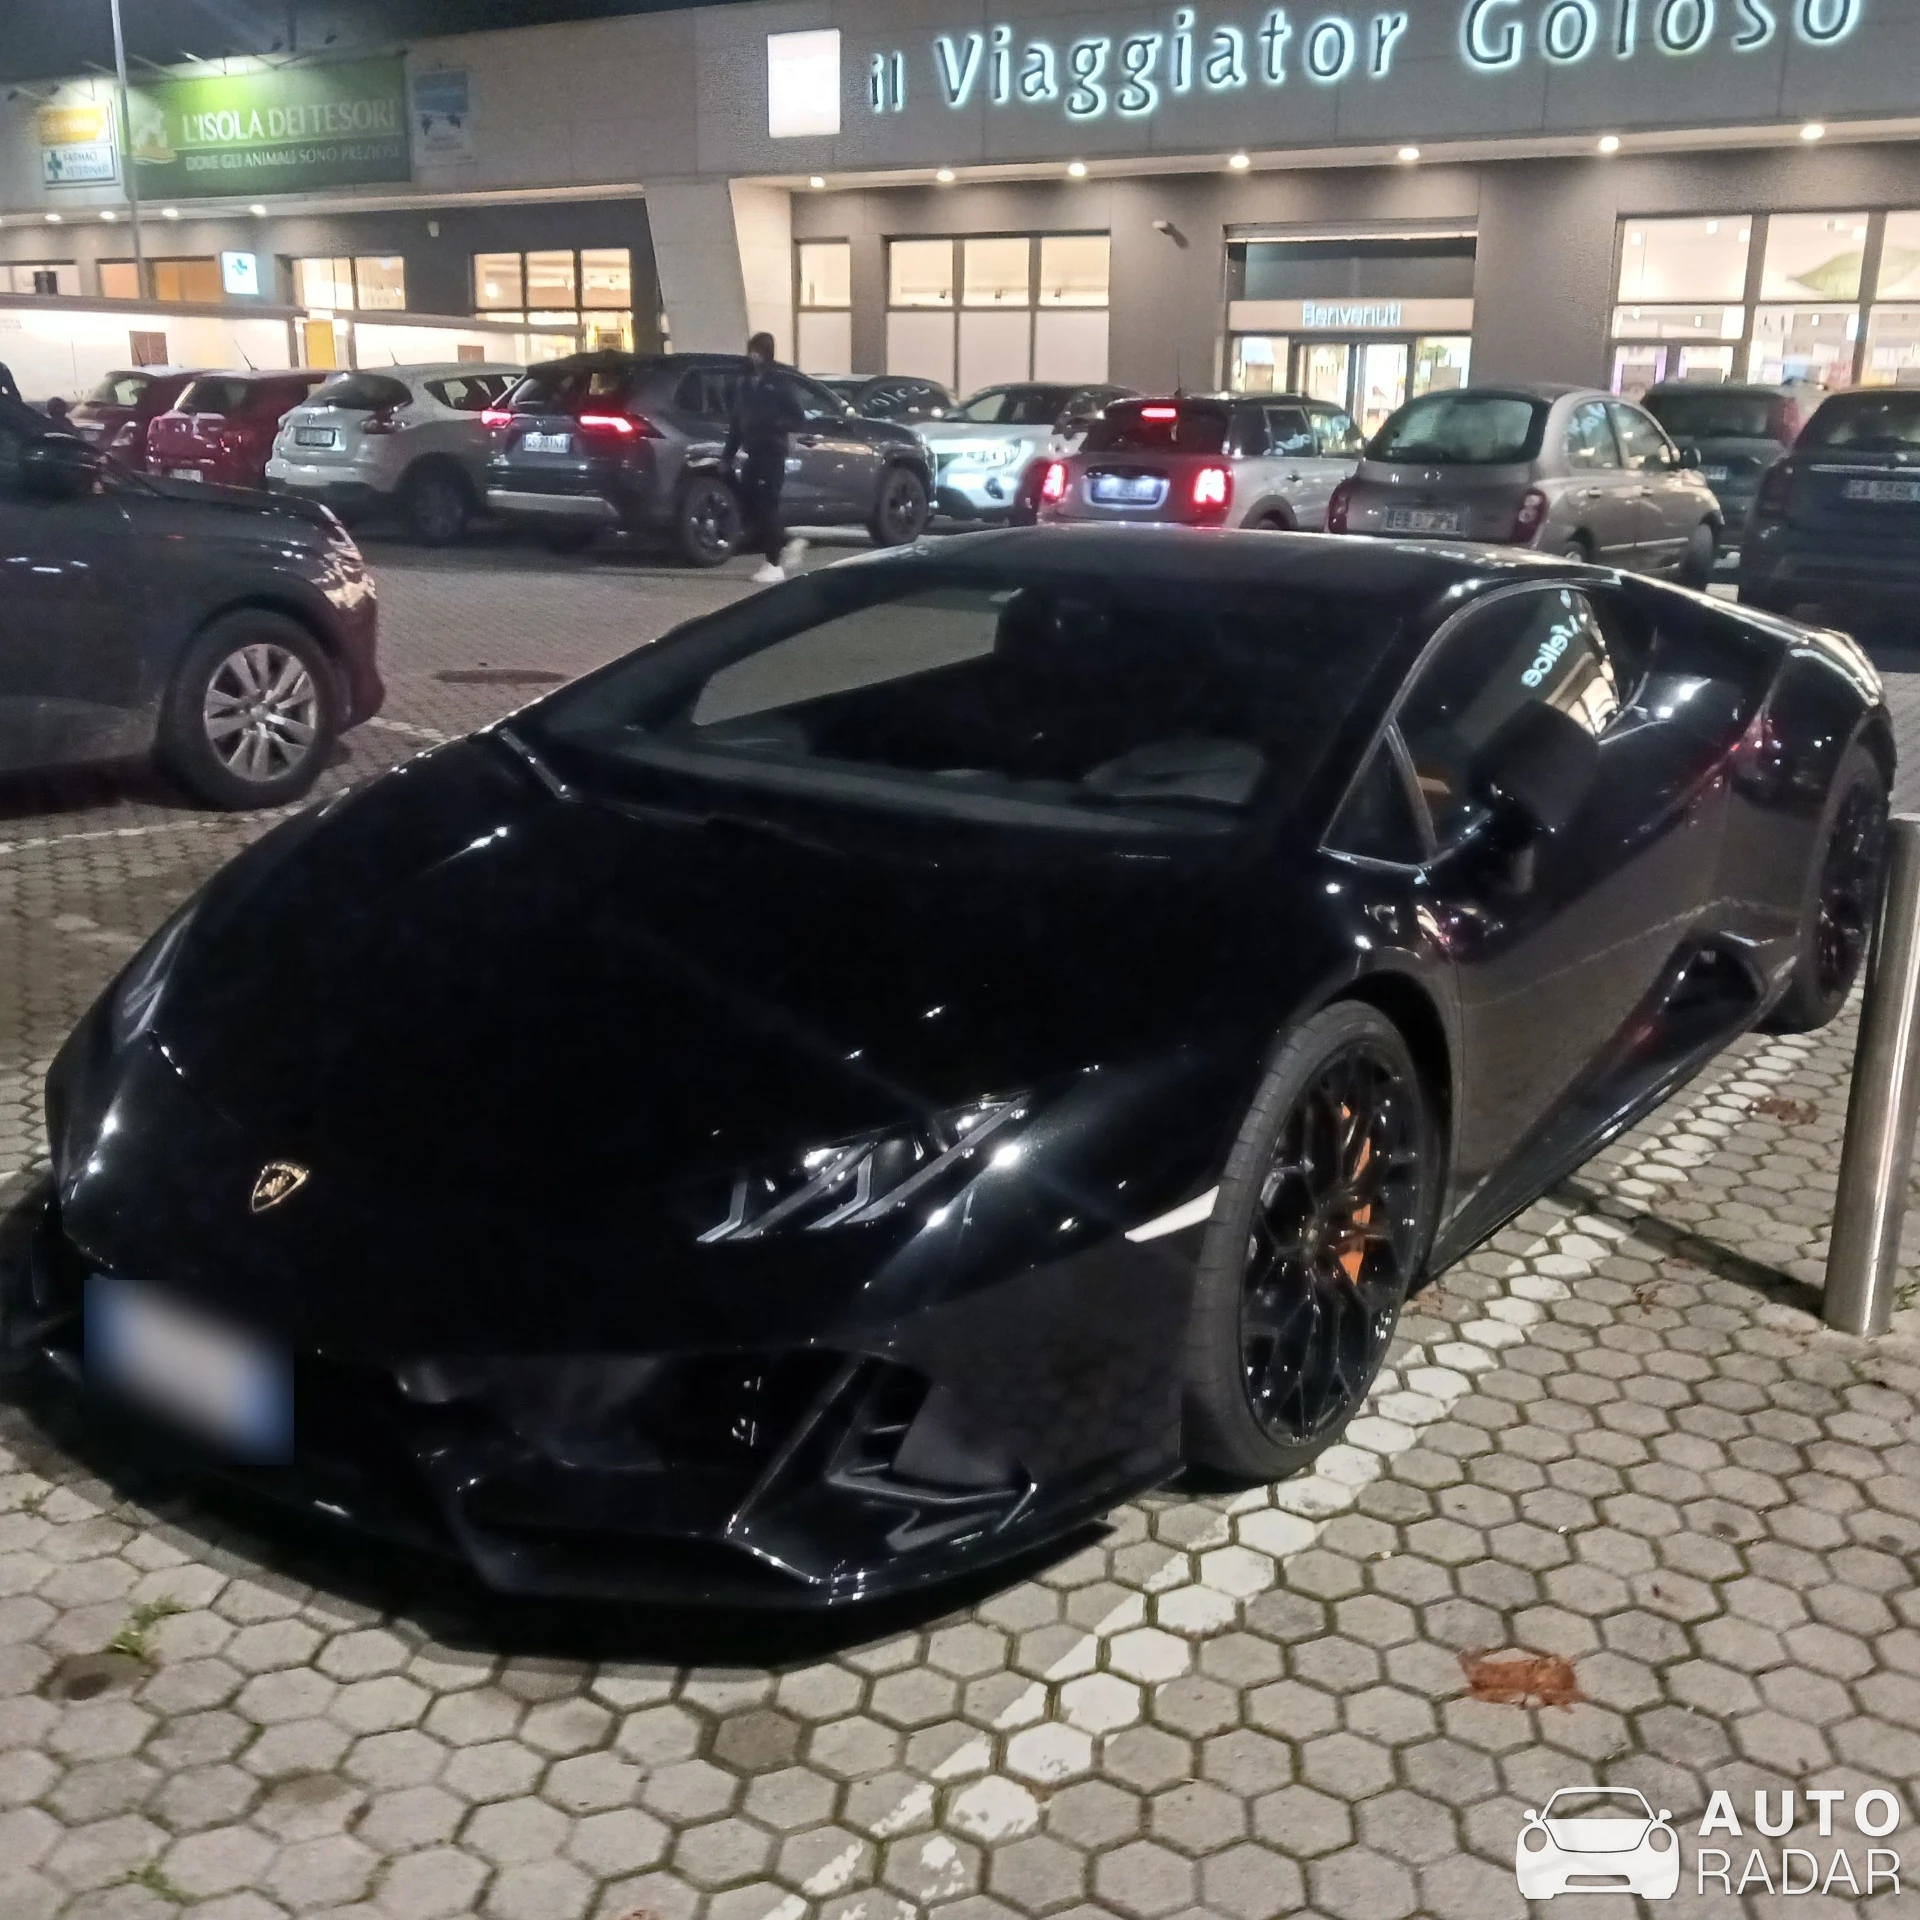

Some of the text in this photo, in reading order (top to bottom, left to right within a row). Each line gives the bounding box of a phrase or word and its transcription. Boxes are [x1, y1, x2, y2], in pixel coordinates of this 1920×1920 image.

[869, 0, 1860, 118] il Viaggiator Goloso
[182, 100, 396, 143] L'ISOLA DEI TESORI
[245, 150, 296, 167] ANIMALI
[300, 147, 337, 163] SONO
[1303, 301, 1402, 328] Benvenuti
